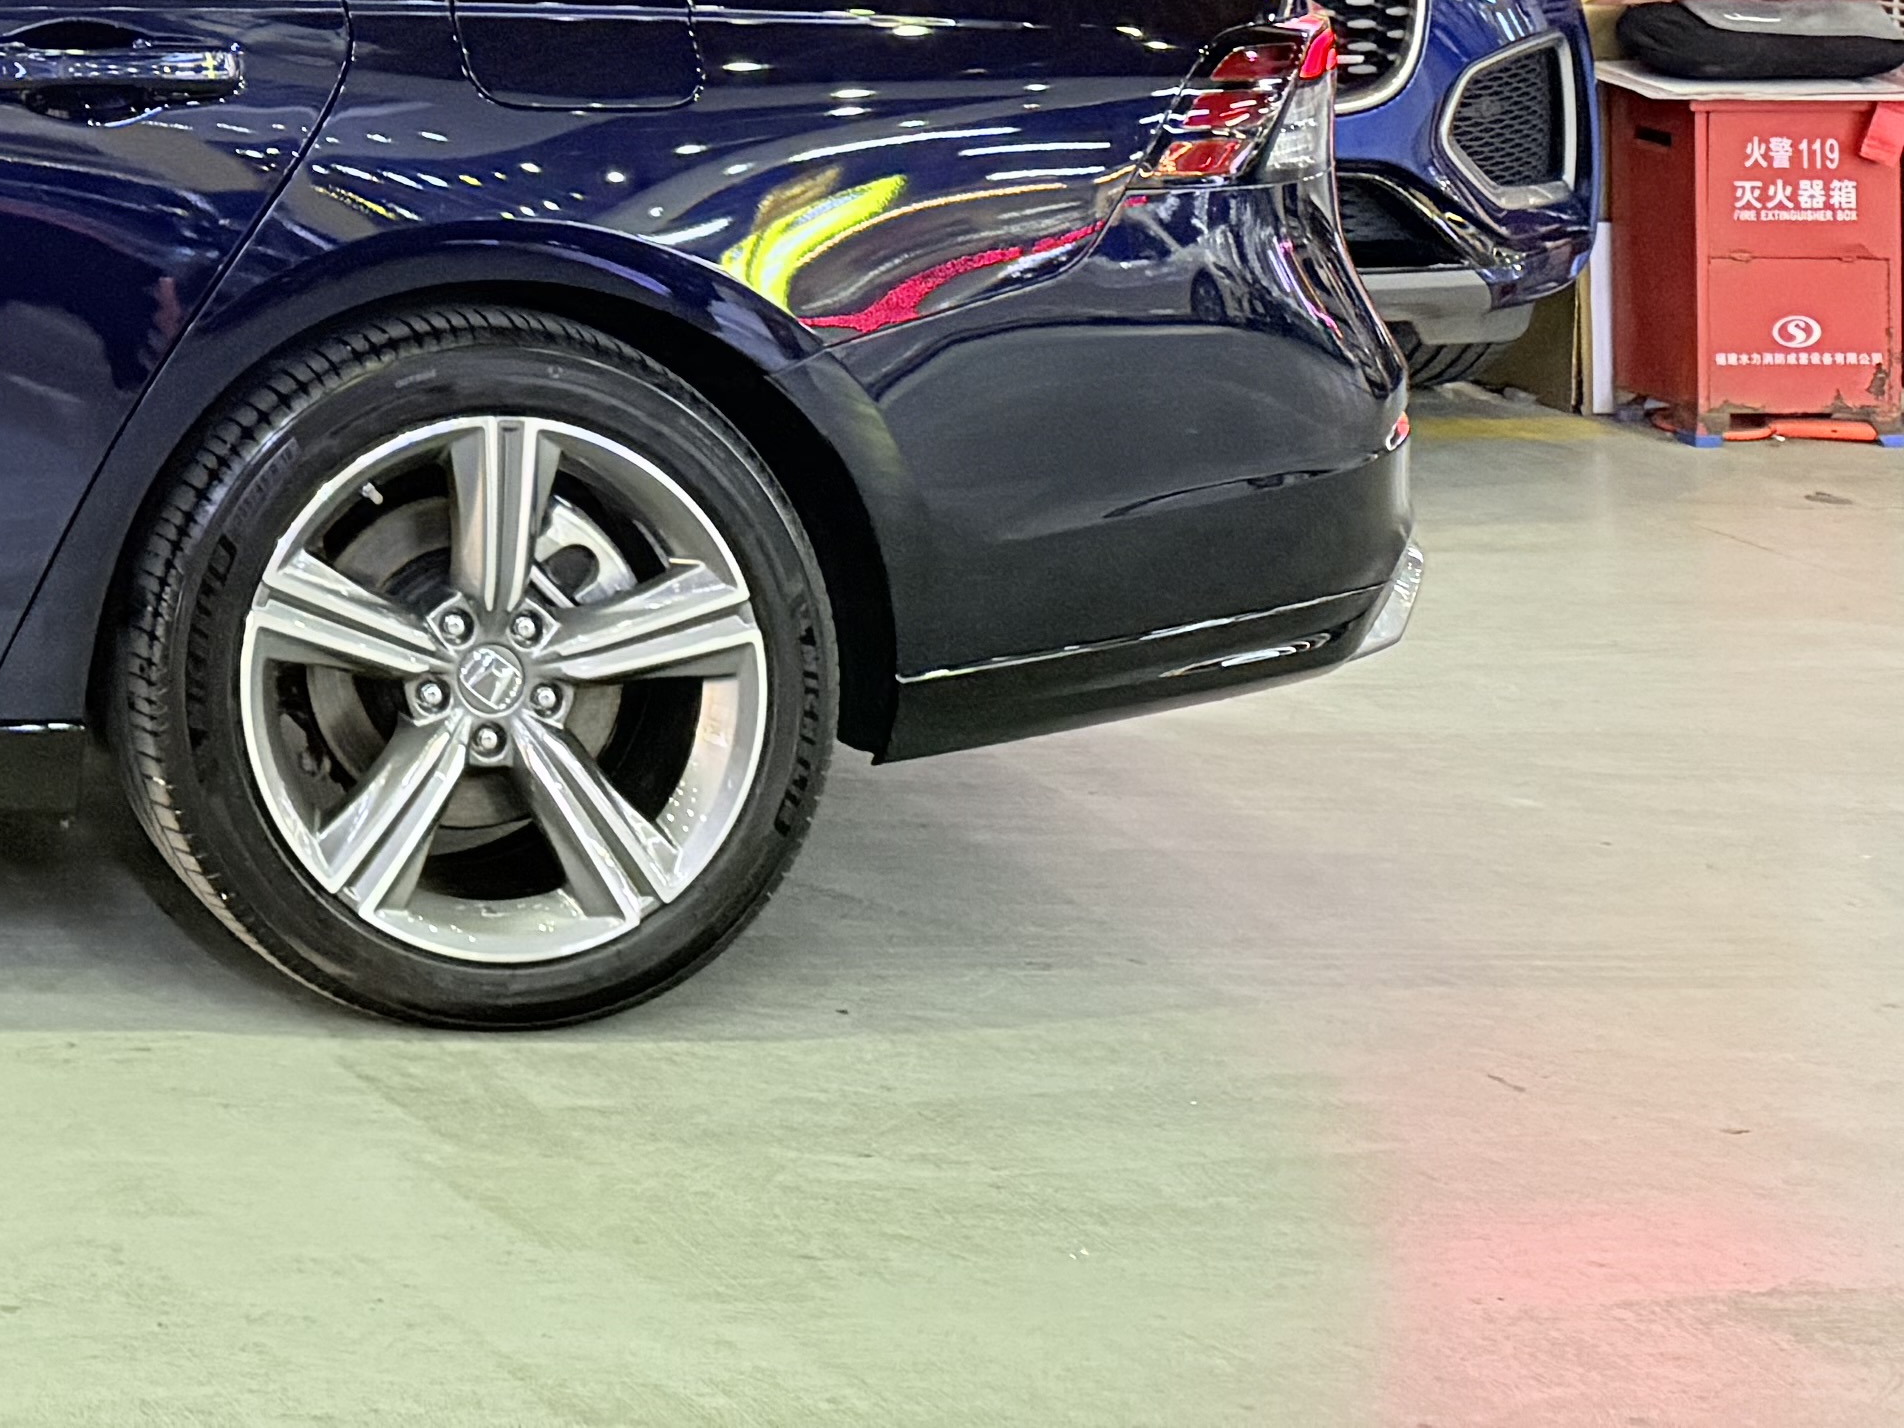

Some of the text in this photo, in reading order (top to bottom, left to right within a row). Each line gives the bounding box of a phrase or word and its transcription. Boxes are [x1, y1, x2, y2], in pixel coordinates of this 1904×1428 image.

[1733, 178, 1858, 210] 灭火器箱
[1733, 210, 1859, 221] FIRE EXTINGUISHER BOX
